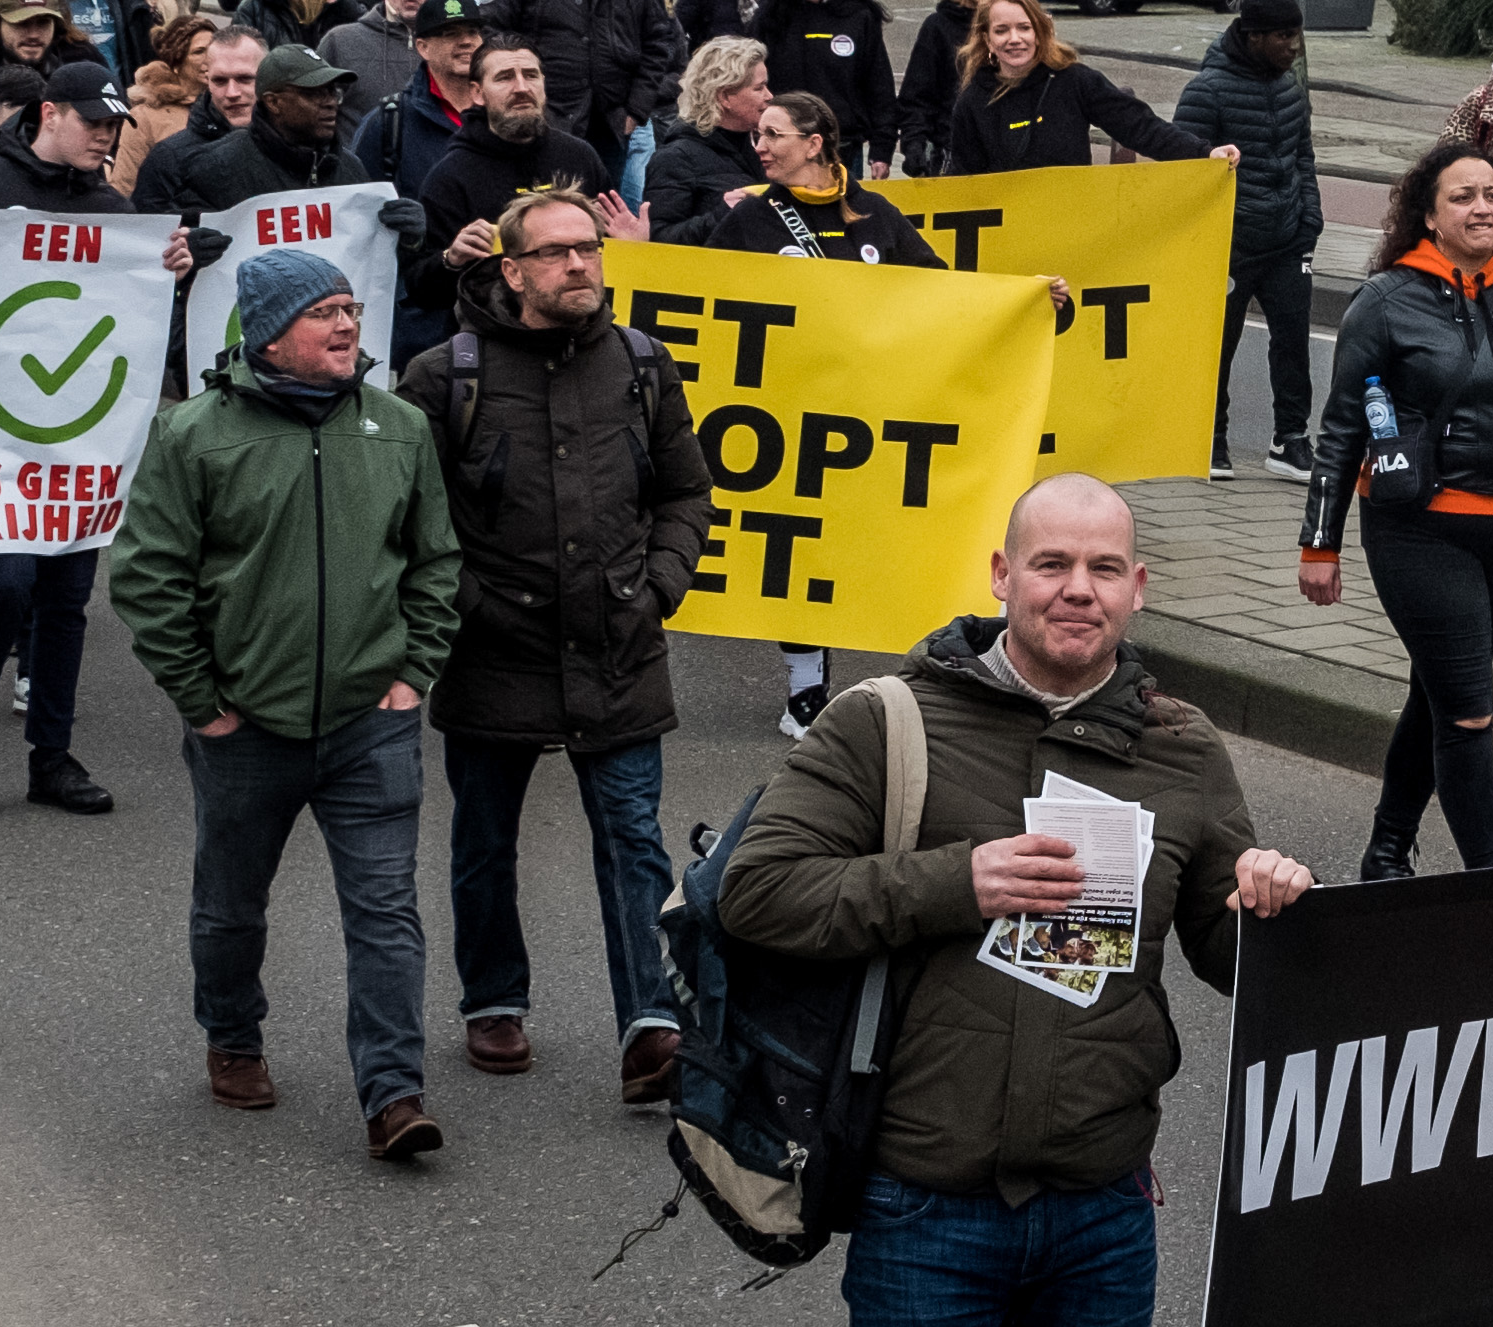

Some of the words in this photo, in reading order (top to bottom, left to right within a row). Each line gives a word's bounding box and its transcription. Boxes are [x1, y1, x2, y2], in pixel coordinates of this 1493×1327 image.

[22, 223, 102, 263] EEN
[257, 202, 332, 246] EEN
[605, 286, 797, 389] ET
[697, 403, 960, 509] OPT
[17, 461, 124, 501] GEEN
